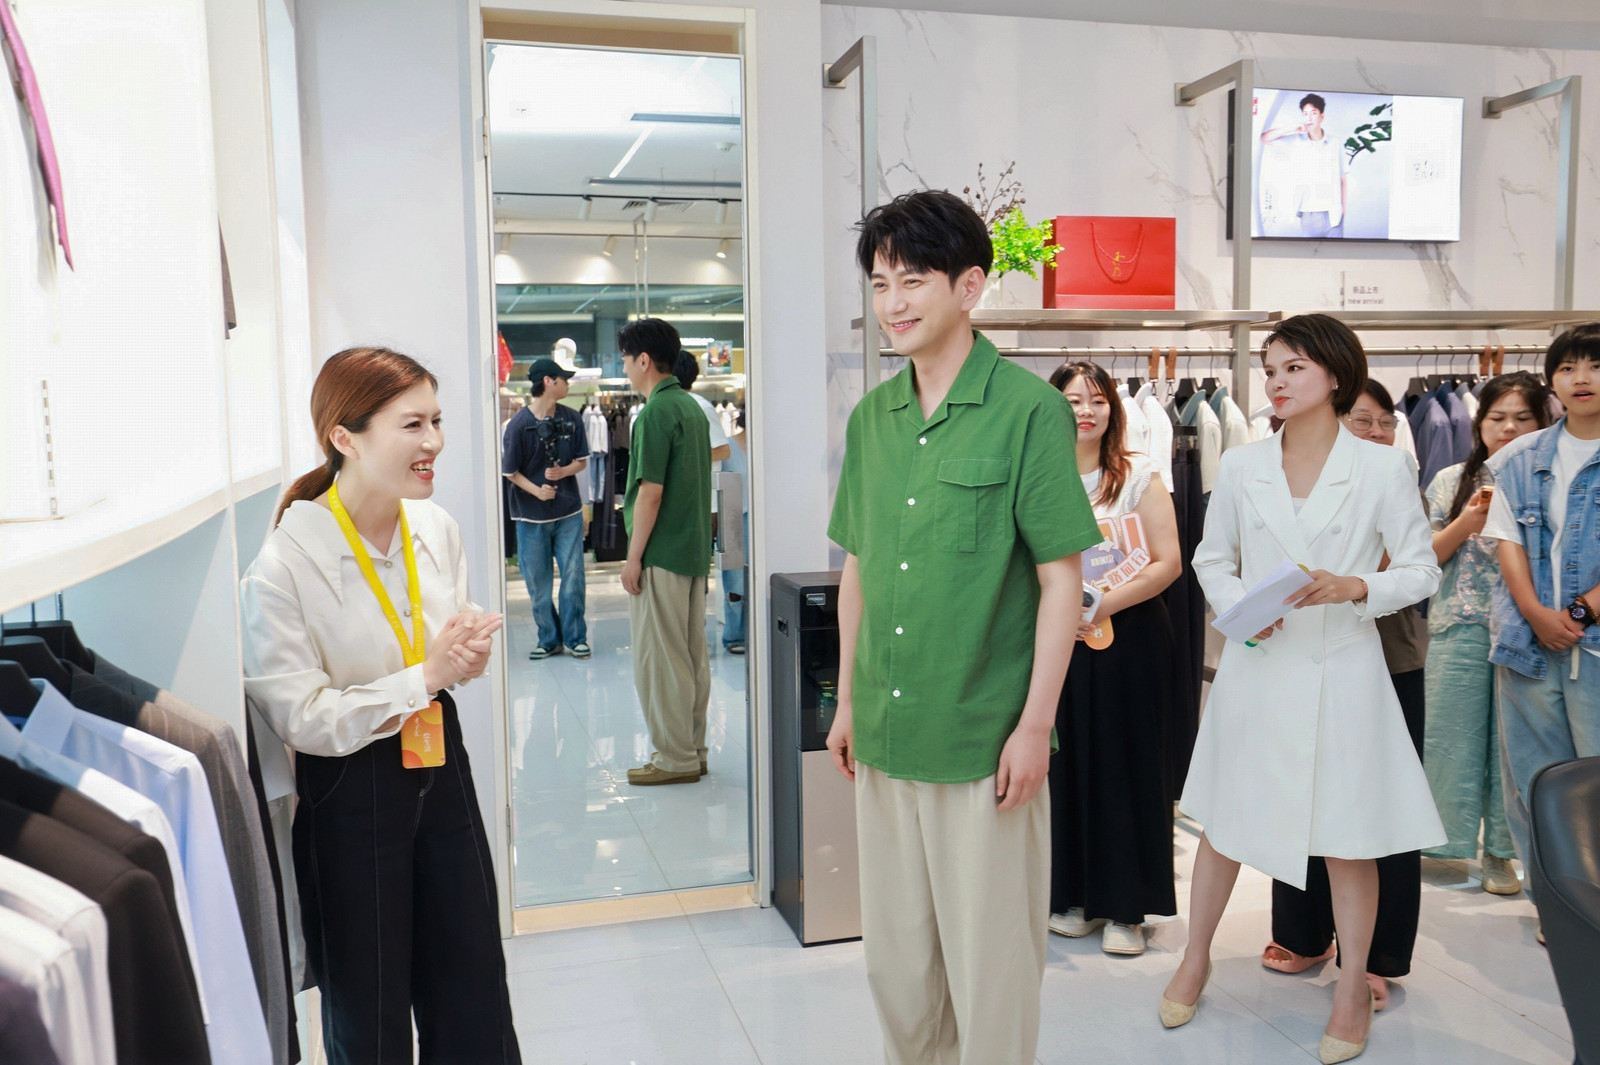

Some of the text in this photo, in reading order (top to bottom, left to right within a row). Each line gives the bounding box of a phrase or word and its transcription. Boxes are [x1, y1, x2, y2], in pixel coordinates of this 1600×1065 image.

[1352, 285, 1379, 294] 新品上市
[1362, 297, 1384, 305] arrival
